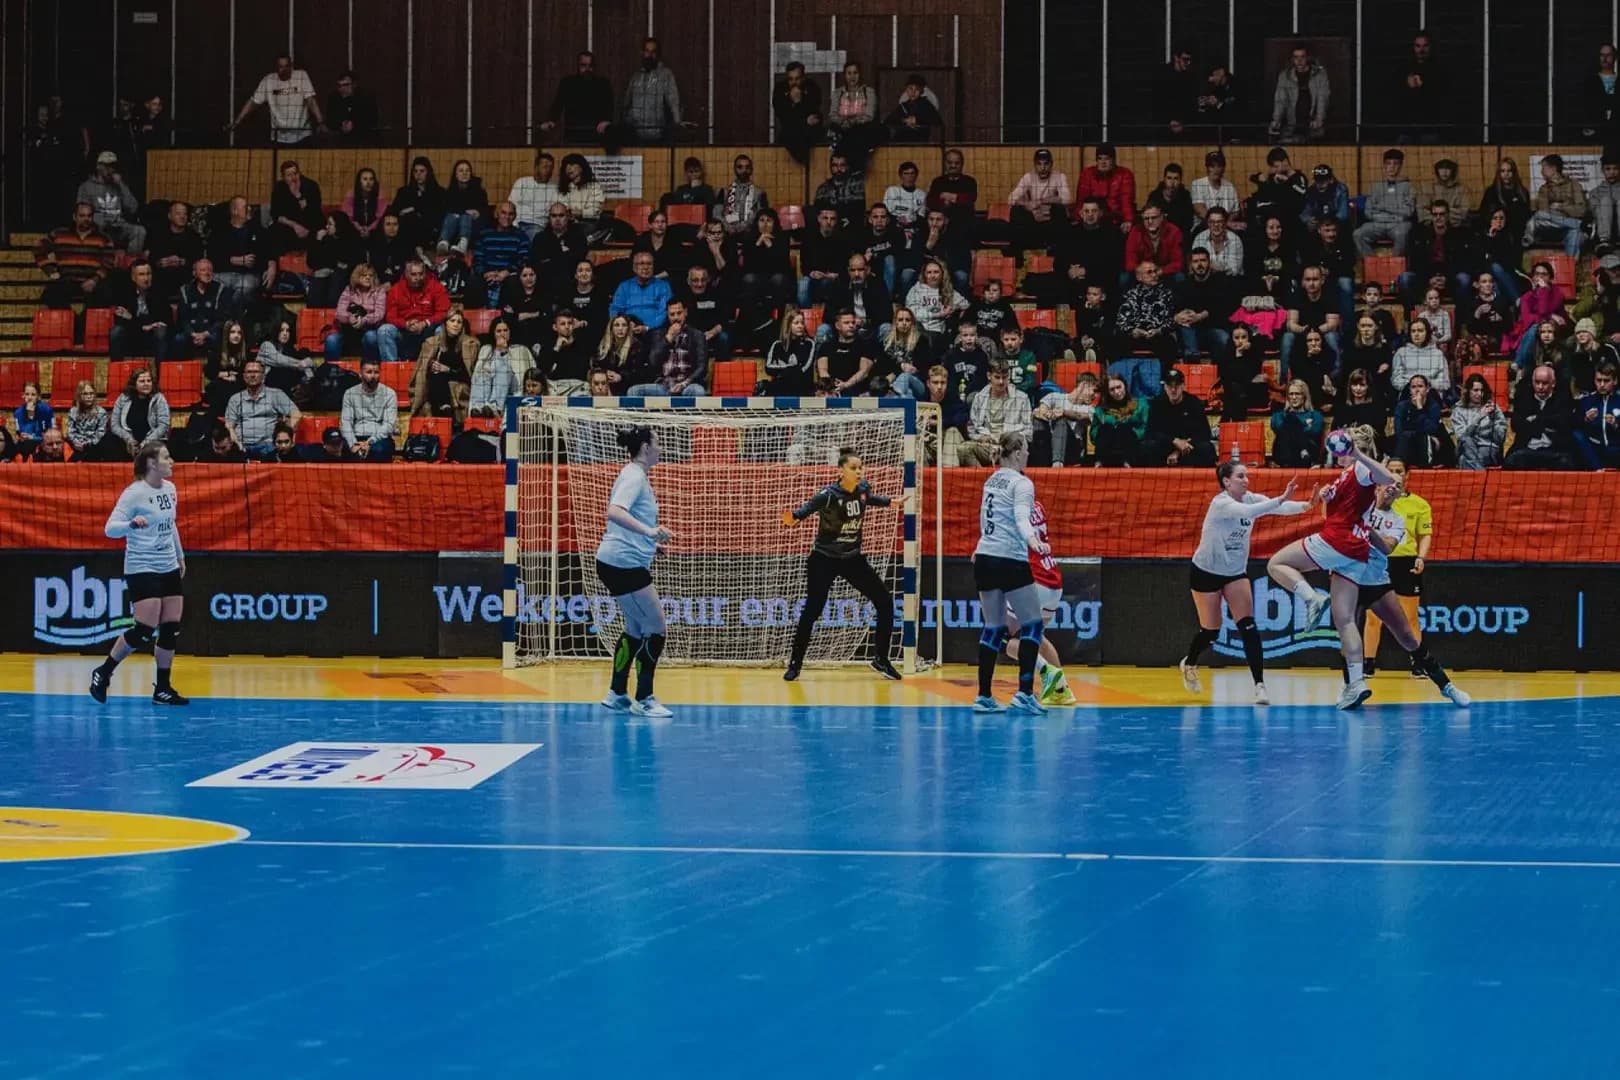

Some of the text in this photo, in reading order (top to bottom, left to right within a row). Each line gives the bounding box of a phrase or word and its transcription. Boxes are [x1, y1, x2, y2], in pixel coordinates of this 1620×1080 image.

[156, 494, 172, 510] 28
[846, 500, 861, 517] 90
[210, 593, 328, 620] GROUP
[432, 585, 503, 622] We
[516, 580, 617, 633] keep
[660, 597, 727, 625] our
